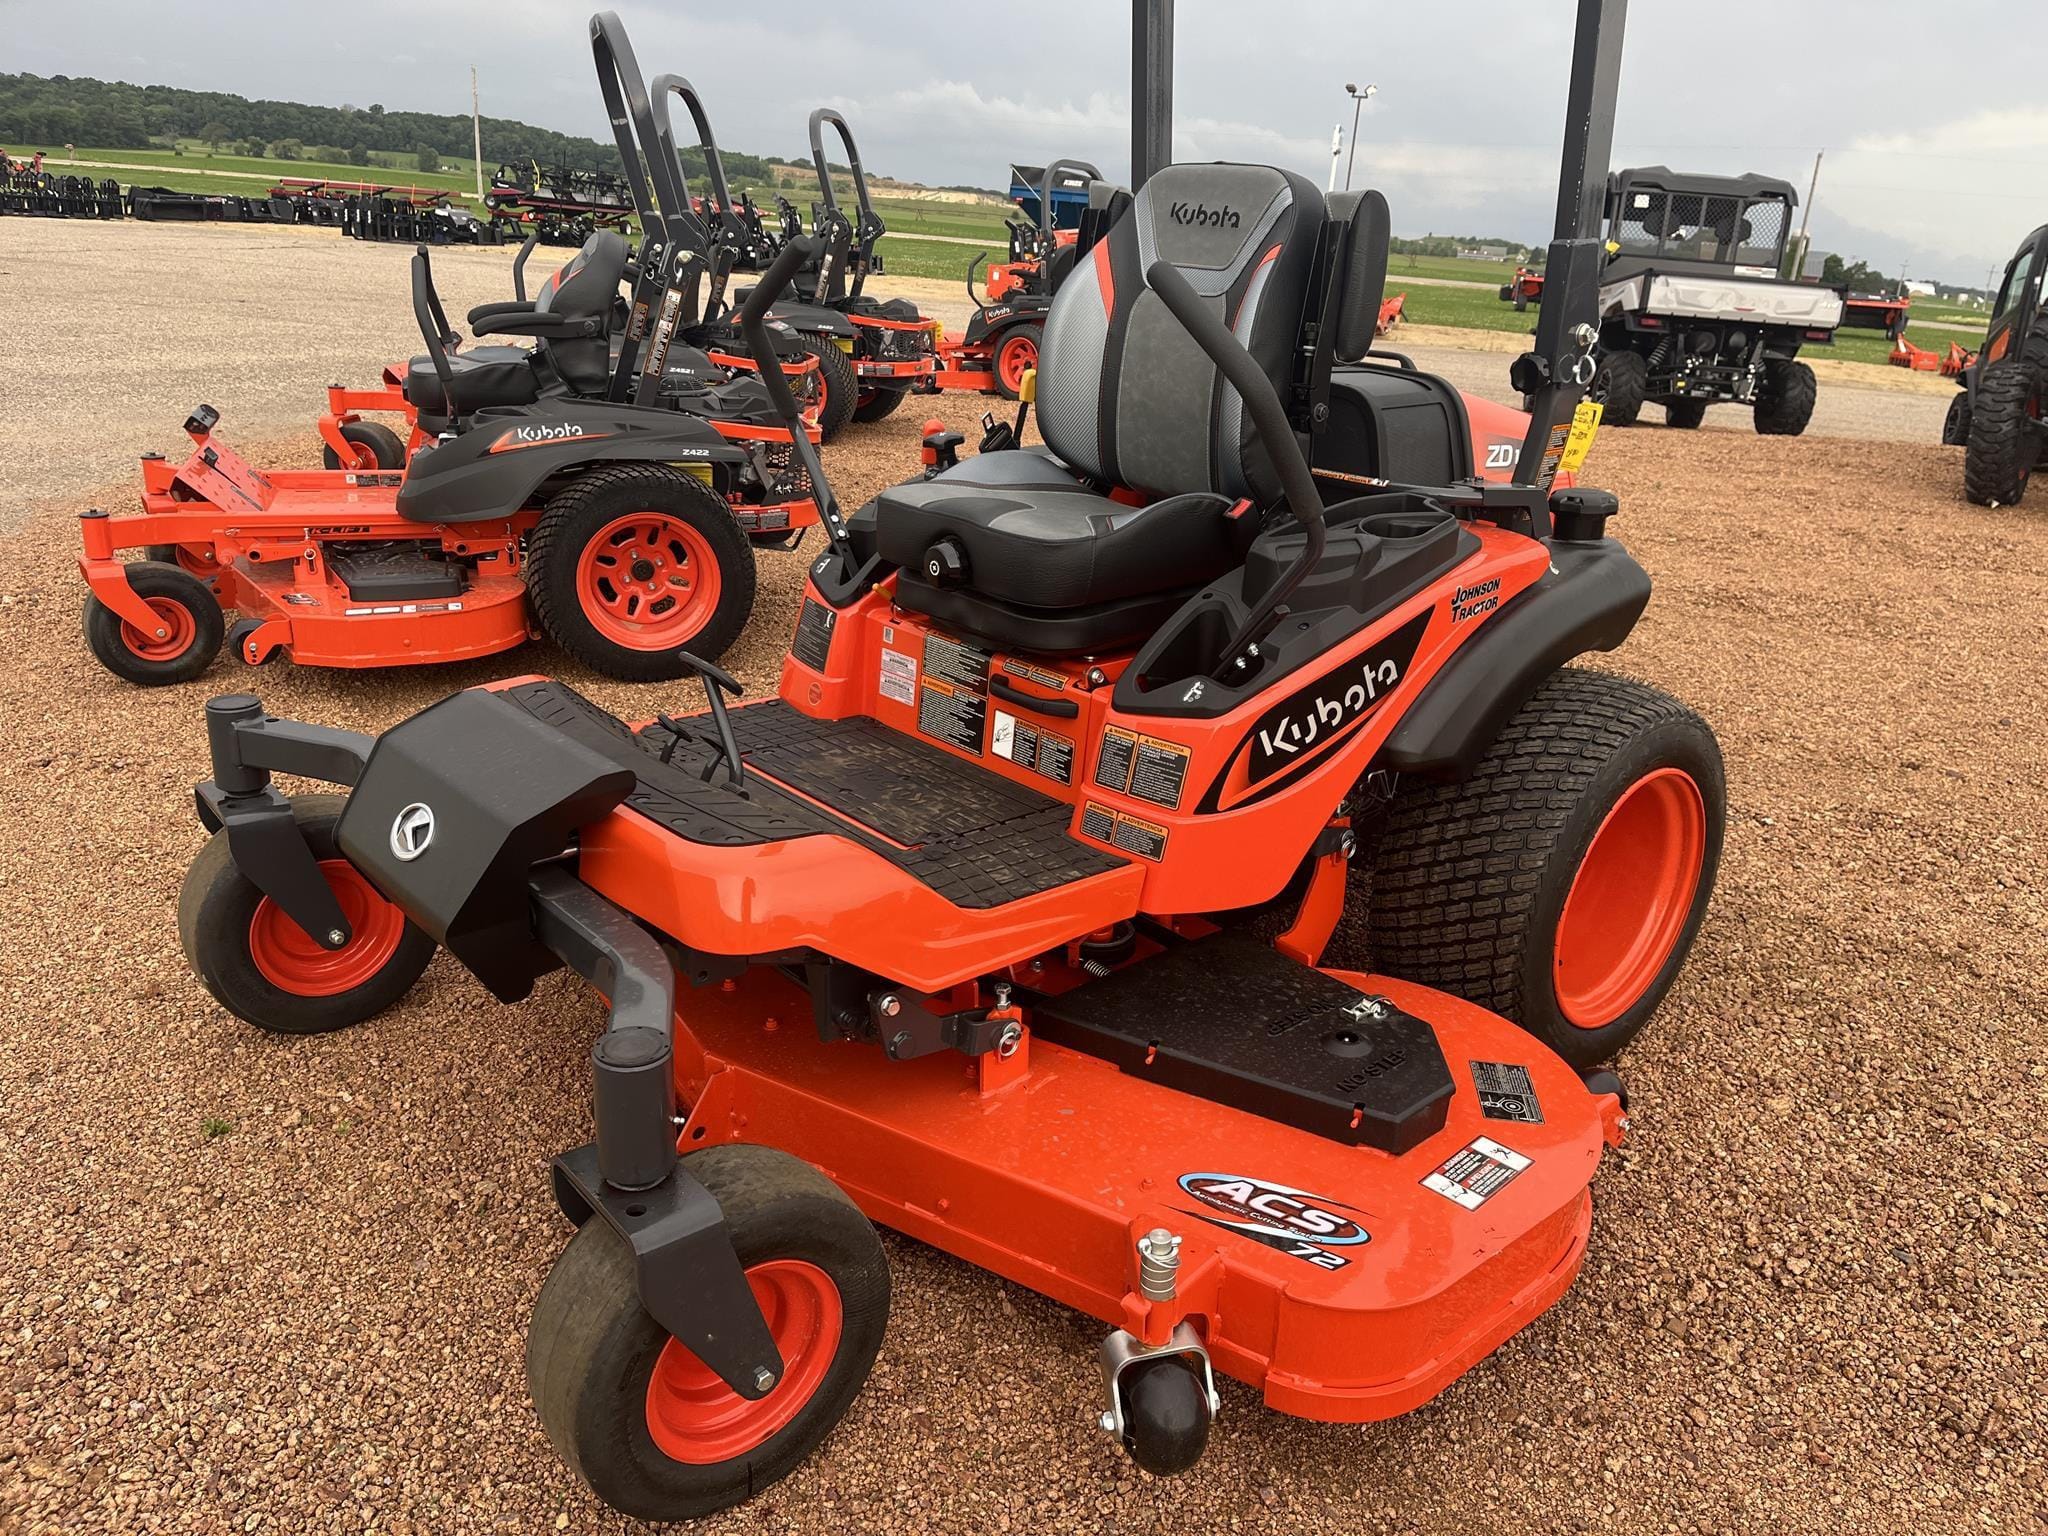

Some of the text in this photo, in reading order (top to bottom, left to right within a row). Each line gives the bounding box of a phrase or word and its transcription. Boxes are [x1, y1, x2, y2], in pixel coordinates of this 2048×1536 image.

[1170, 202, 1241, 229] Kubota
[988, 307, 1011, 318] Kubota
[517, 423, 583, 441] Kubota
[682, 449, 710, 457] Z422
[310, 526, 369, 535] K-LIFT
[1450, 578, 1501, 606] JOHNSON
[1450, 596, 1499, 624] TRACTOR
[1259, 659, 1399, 757] Kubota
[1113, 729, 1134, 739] WARNING
[1150, 739, 1185, 753] ADVERTENCIA
[1092, 803, 1115, 817] WARNING
[1126, 817, 1163, 834] ADVERTENCIA
[1336, 1049, 1407, 1093] NO STEP
[1446, 1150, 1470, 1168] DANGER
[1472, 1163, 1495, 1182] PELIGRO
[1193, 1189, 1323, 1243] Aerodynamic Cutting System
[1201, 1180, 1348, 1235] ACS
[1286, 1242, 1346, 1270] 72
